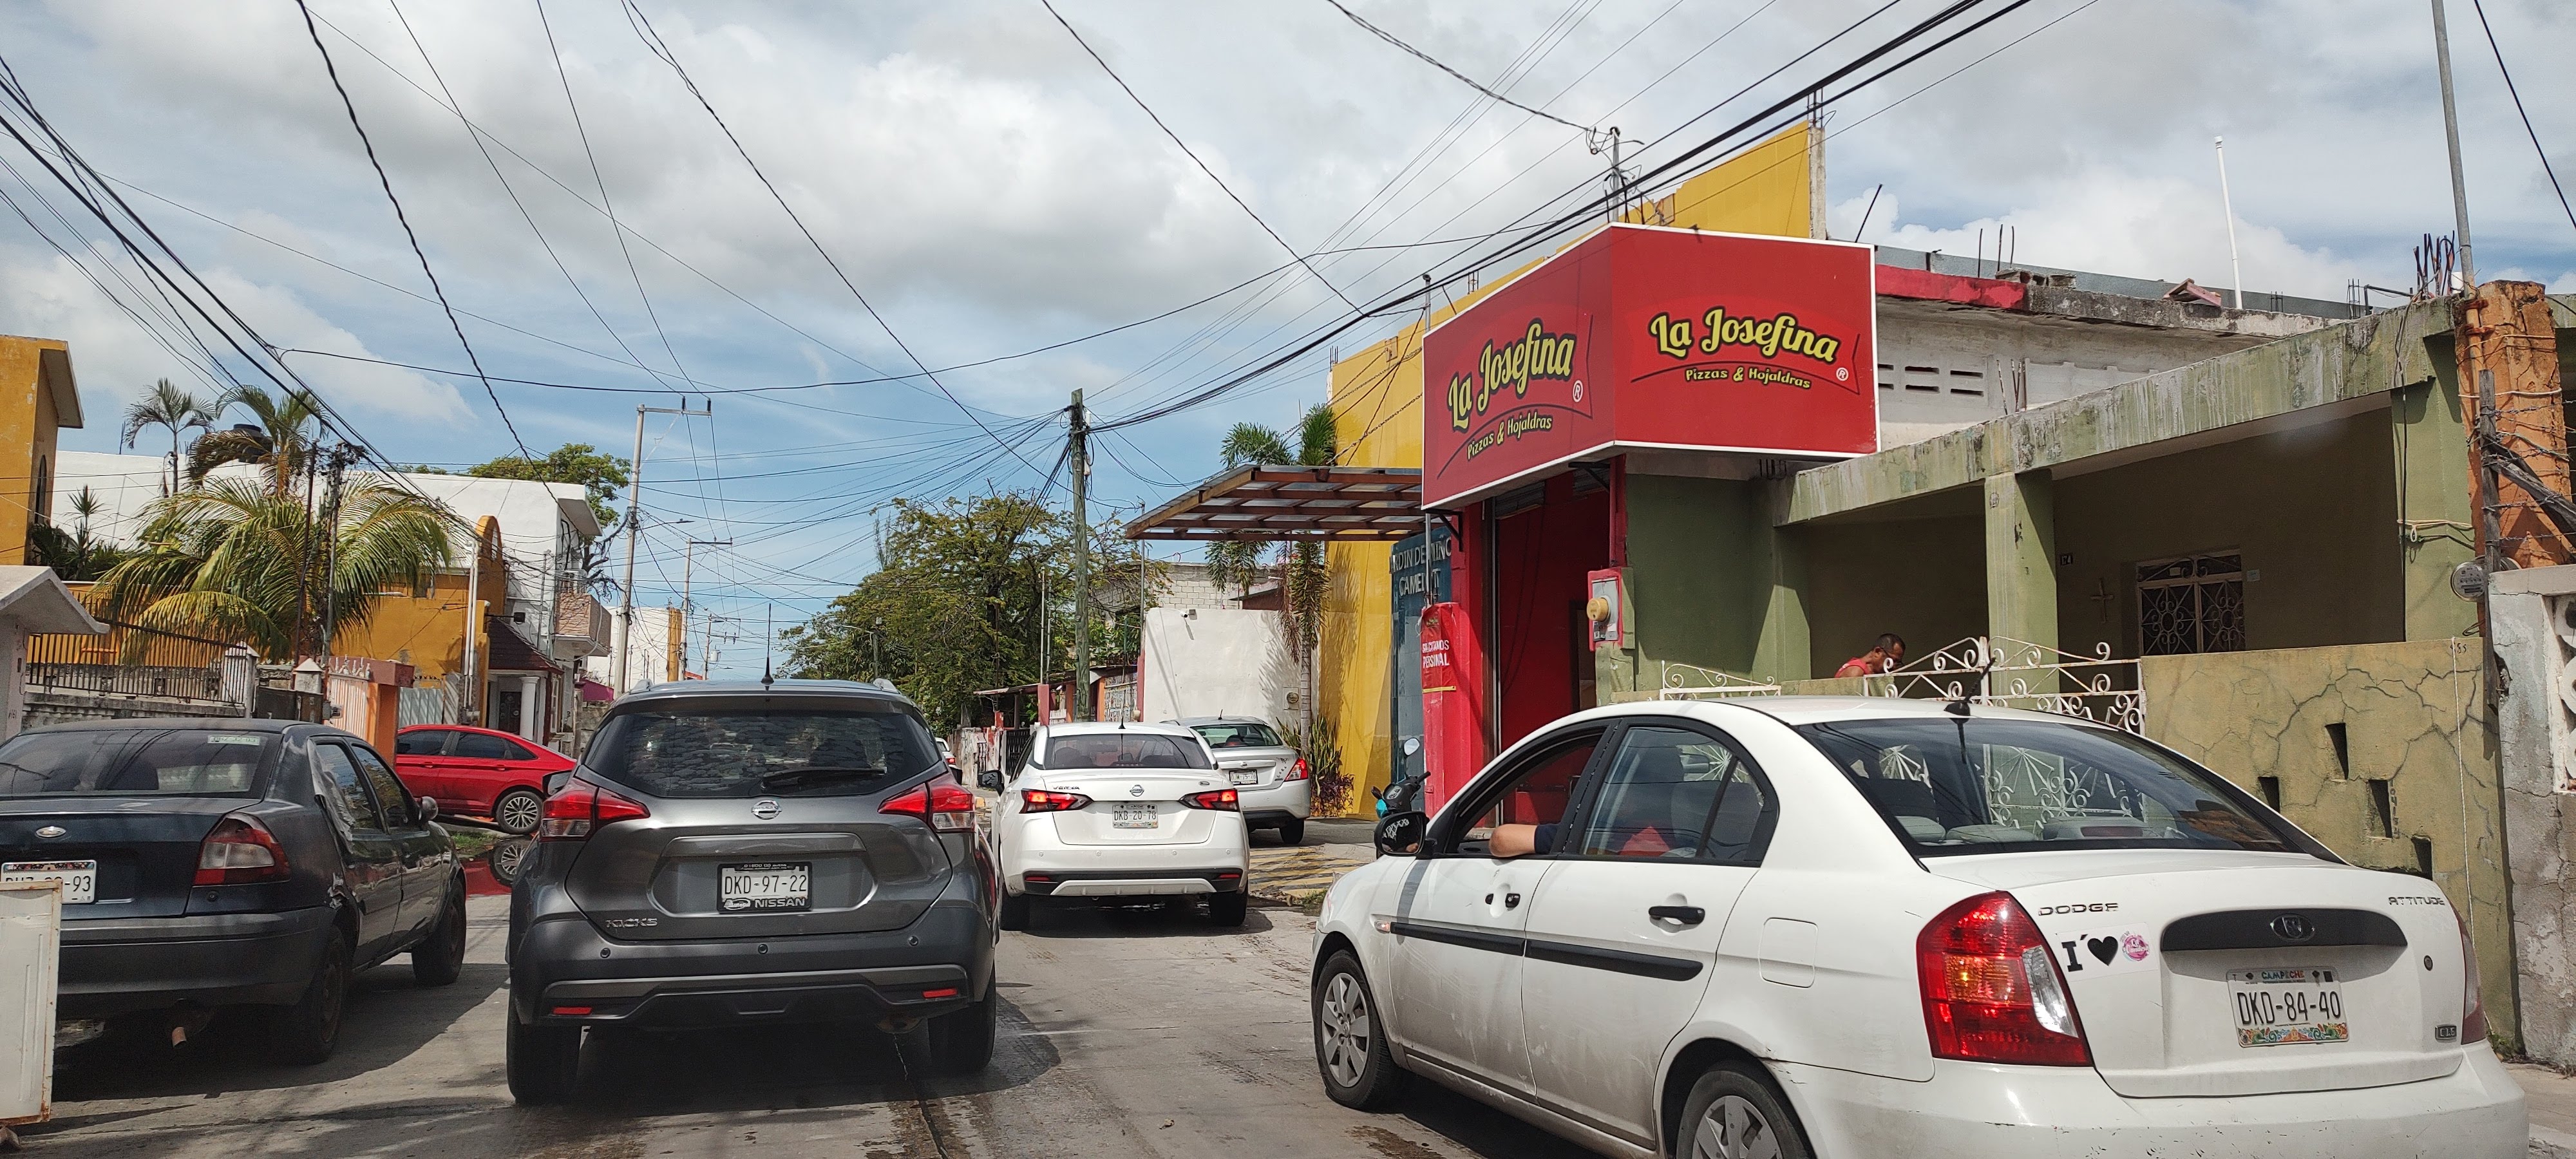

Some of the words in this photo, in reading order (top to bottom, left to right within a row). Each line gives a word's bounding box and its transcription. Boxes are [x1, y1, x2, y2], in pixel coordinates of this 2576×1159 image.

[1651, 315, 1692, 357] La
[1701, 308, 1839, 363] Josefina
[1448, 375, 1473, 429] La
[1478, 323, 1575, 411] Josefina
[1685, 368, 1728, 381] Pizzas
[1733, 367, 1744, 382] &
[1748, 368, 1811, 388] Hojaldras
[1467, 433, 1495, 460] Pizzas
[1497, 422, 1505, 445] &
[1508, 411, 1553, 438] Hojaldras
[1399, 568, 1441, 597] CAMELT
[724, 874, 807, 894] DKD-97-22
[755, 898, 805, 908] NISSAN
[2038, 903, 2119, 916] DODGE
[2388, 896, 2445, 905] ATTITUDE
[2237, 991, 2342, 1025] DKD-84-40
